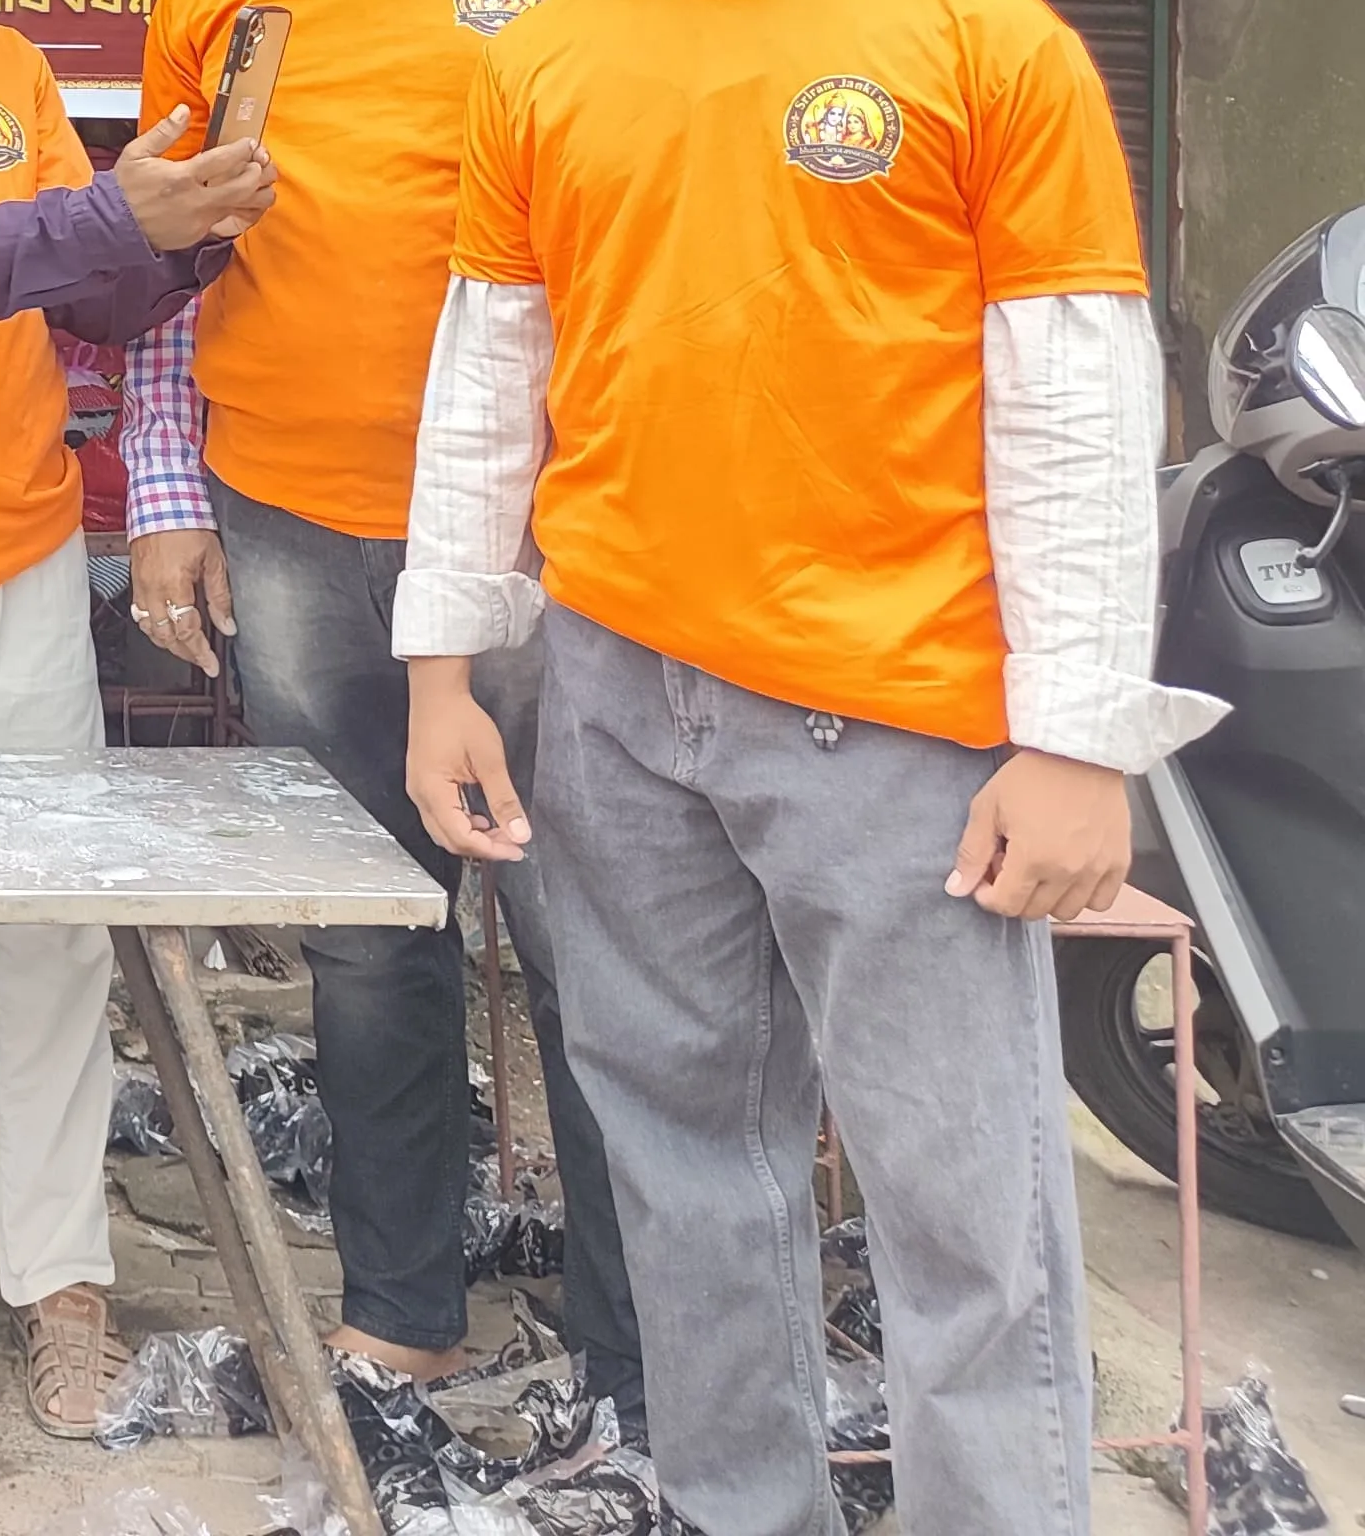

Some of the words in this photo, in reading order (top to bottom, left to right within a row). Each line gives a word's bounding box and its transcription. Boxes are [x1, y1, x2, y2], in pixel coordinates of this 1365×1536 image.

[795, 80, 835, 110] Sriram
[838, 78, 876, 97] Janki
[1257, 562, 1306, 582] TVS
